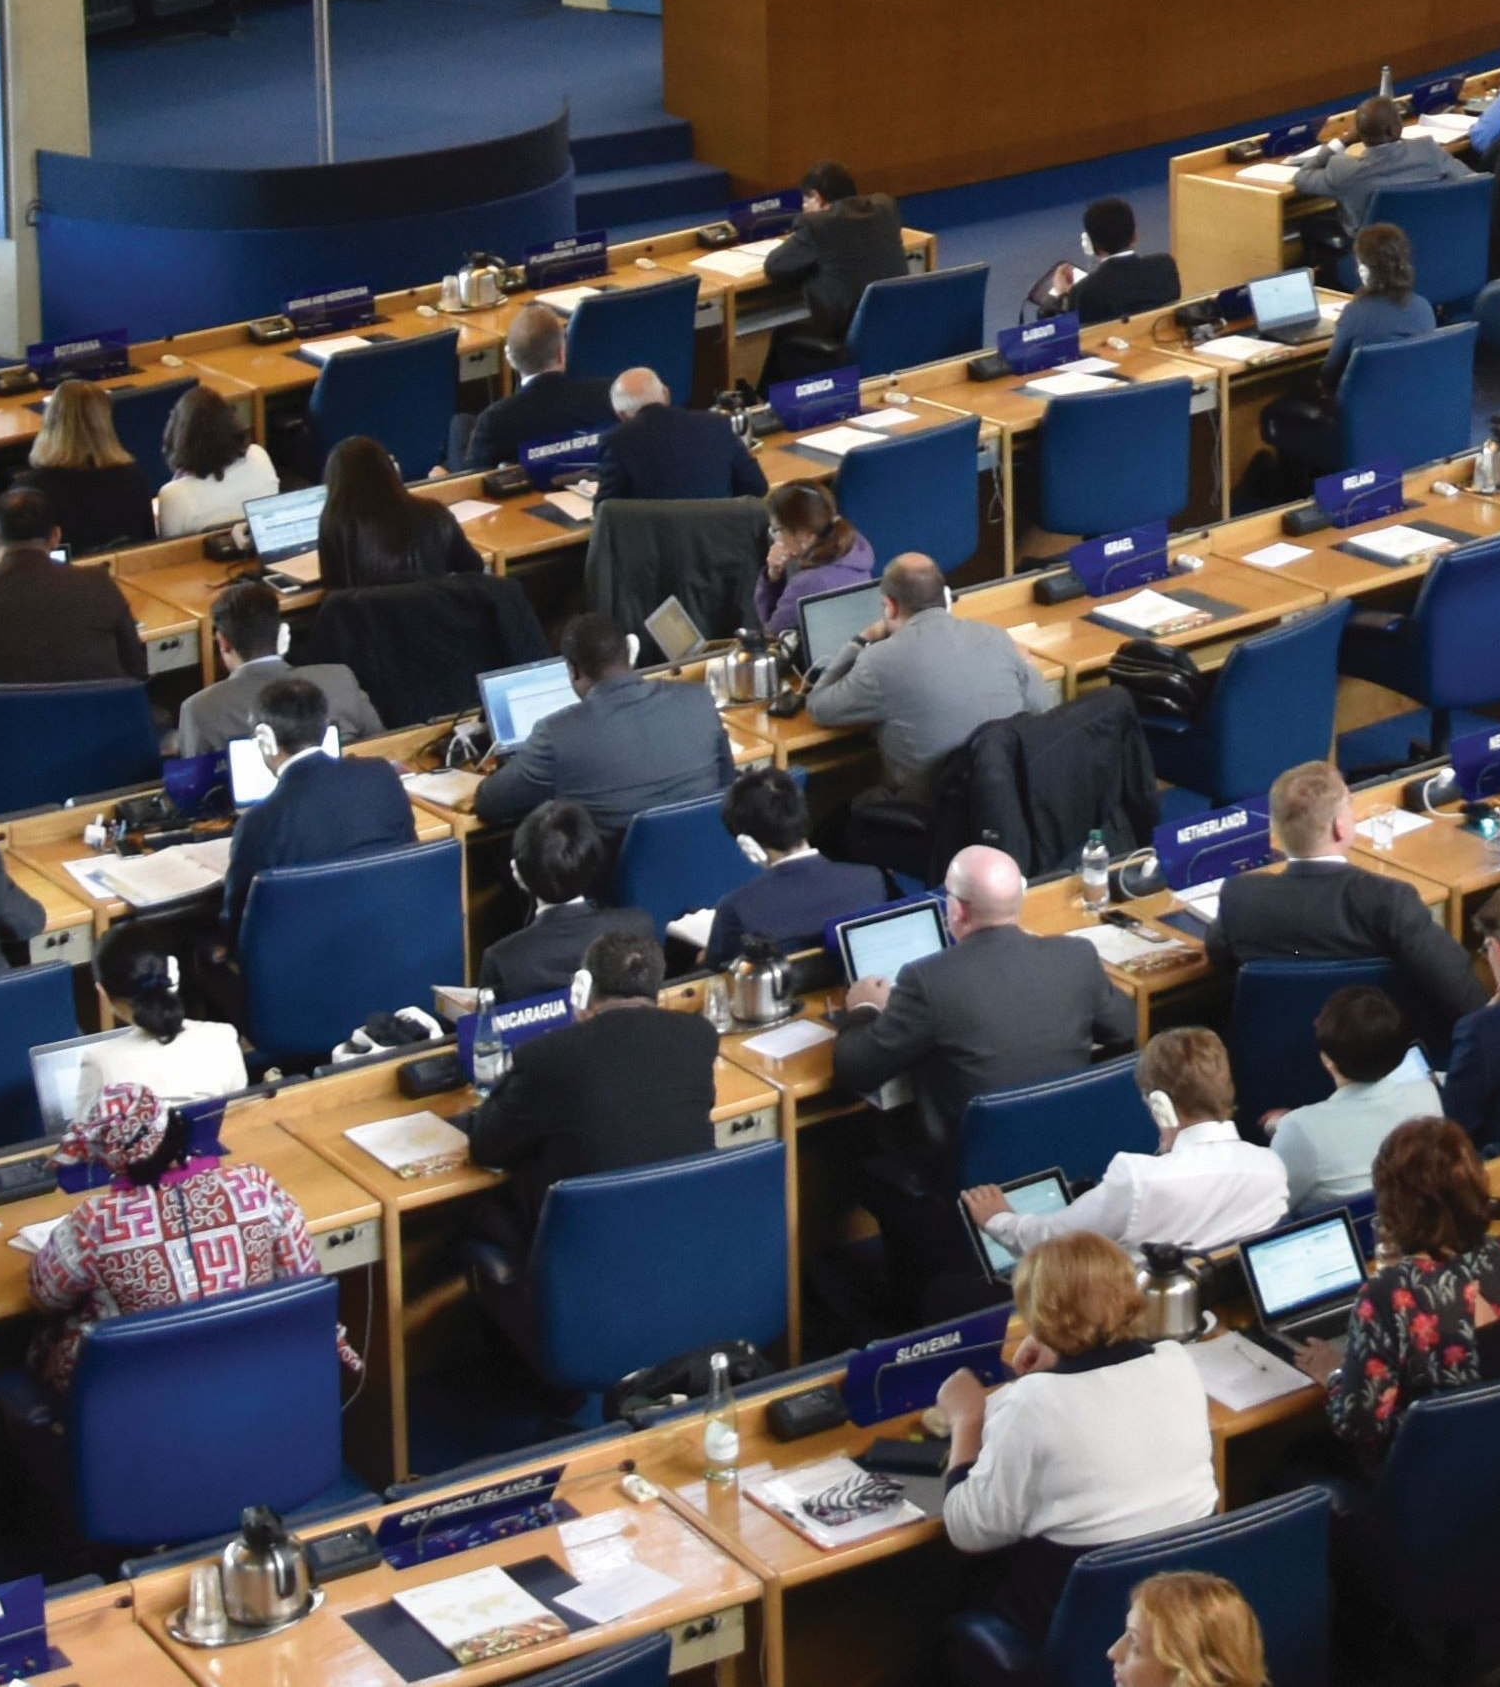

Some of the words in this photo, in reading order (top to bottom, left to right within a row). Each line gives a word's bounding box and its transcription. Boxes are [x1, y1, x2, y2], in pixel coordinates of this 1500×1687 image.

[53, 339, 100, 358] BOTSWANA
[527, 441, 571, 460] DOMINICAN
[571, 433, 599, 450] REPUB
[1342, 471, 1376, 490] IRELAND
[1104, 537, 1134, 556] ISRAEL
[1177, 810, 1248, 844] NETHERLANDS
[492, 999, 567, 1033] NICARAGUA
[896, 1330, 962, 1364] SLOVENIA
[399, 1494, 477, 1527] SOLOMON
[477, 1475, 543, 1505] ISLANDS
